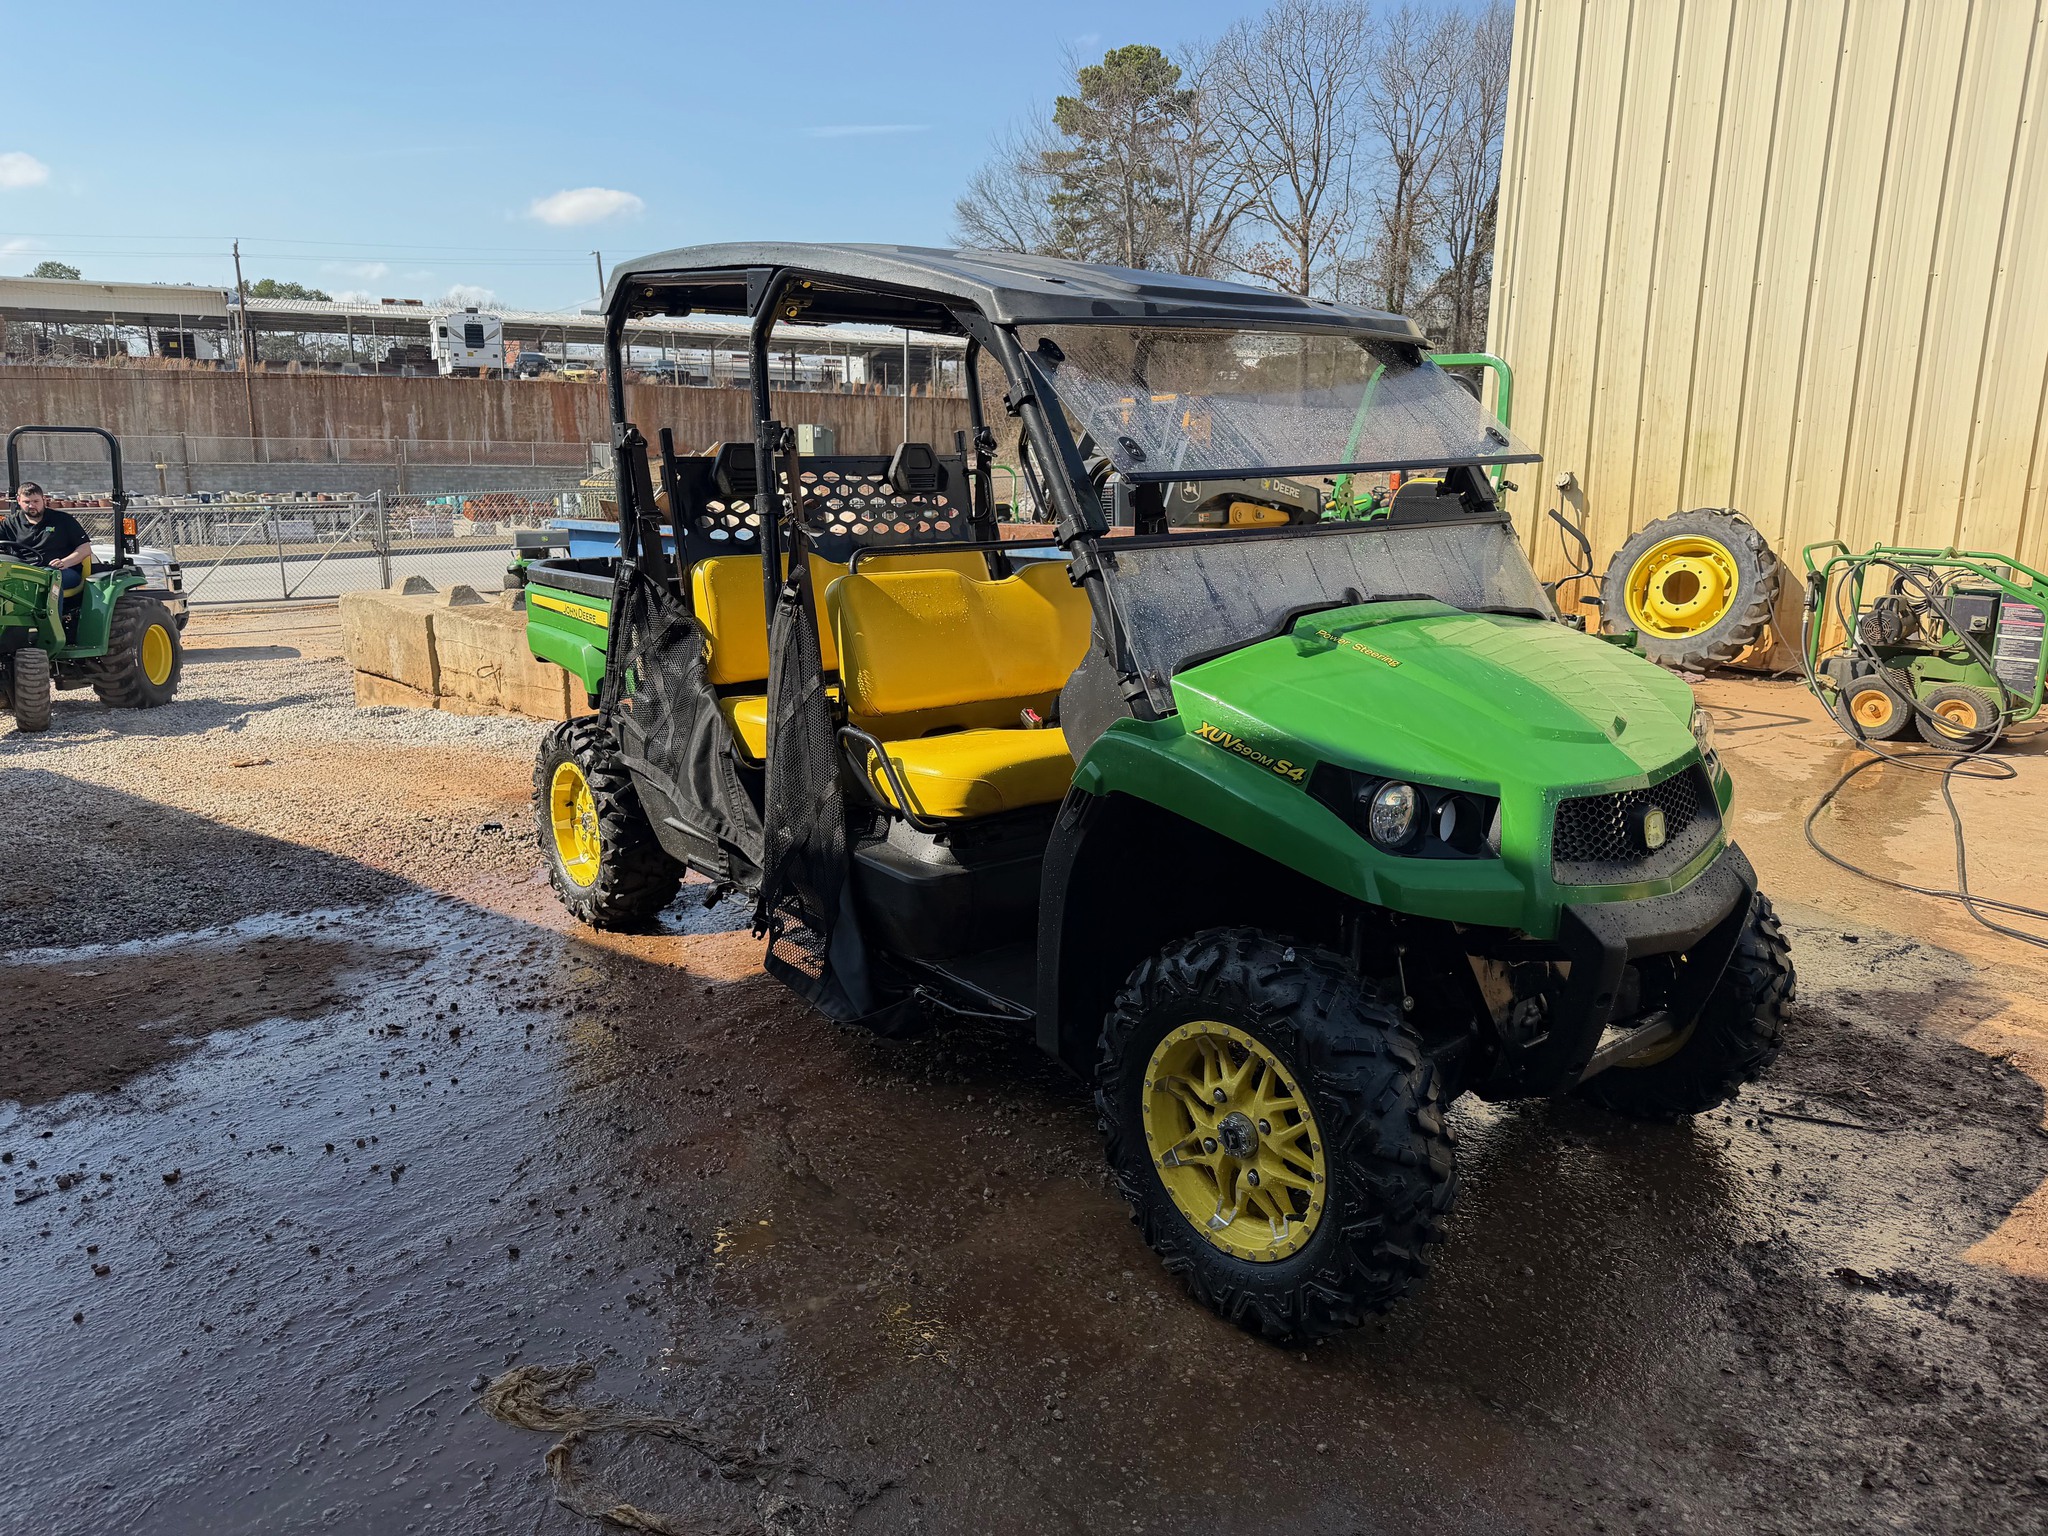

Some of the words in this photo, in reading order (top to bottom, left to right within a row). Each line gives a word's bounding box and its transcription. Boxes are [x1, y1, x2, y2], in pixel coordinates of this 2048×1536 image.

[1272, 480, 1300, 499] DEERE
[563, 604, 578, 619] JOHN
[578, 608, 596, 623] DEERE
[1315, 629, 1351, 645] Power
[1352, 643, 1400, 667] Steering
[1273, 759, 1307, 781] S4
